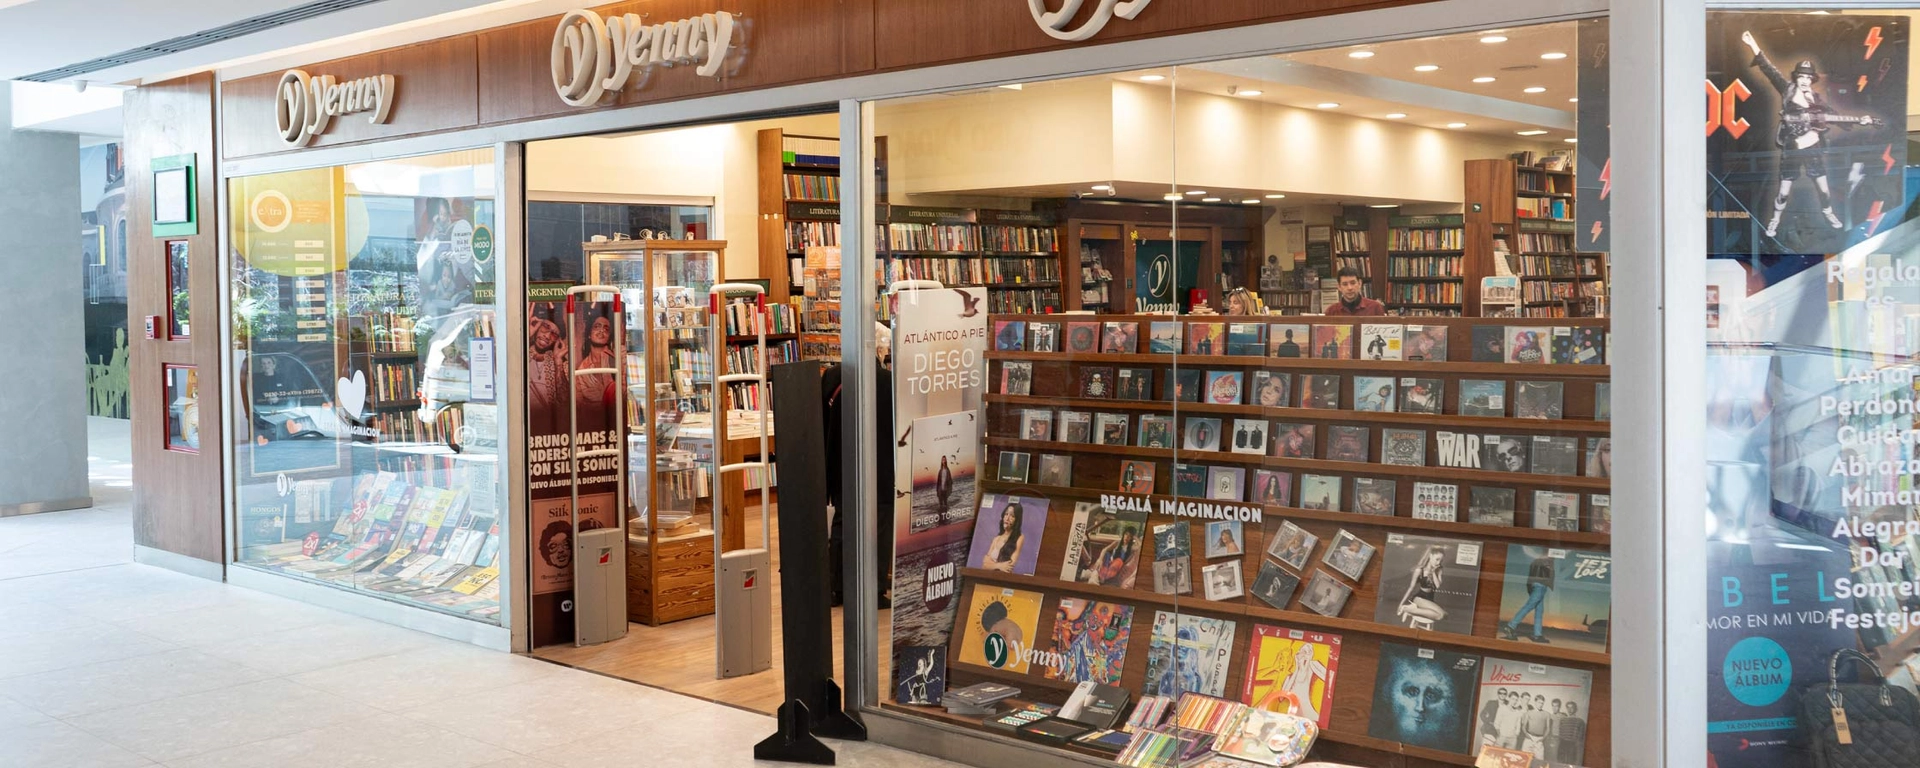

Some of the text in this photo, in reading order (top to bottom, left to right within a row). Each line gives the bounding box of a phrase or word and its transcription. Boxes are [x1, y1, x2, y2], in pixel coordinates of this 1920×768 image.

[603, 10, 735, 92] Yenny
[309, 74, 395, 136] Yenny
[475, 289, 494, 298] ITER
[528, 287, 567, 296] ARGENTIN
[904, 328, 984, 344] ATLÁNTICO A PIE
[914, 348, 975, 374] DIEGO
[907, 369, 980, 395] TORRES
[576, 431, 606, 445] MARS
[1436, 432, 1481, 469] WAR
[583, 457, 618, 472] SONIC
[531, 481, 548, 489] UEVO
[251, 506, 281, 514] HONGOS
[548, 504, 599, 518] Silk onic
[915, 507, 971, 527] DIEGO TORRES
[1100, 494, 1262, 523] REGALÁ IMAGINACION
[1832, 517, 1920, 540] Alegra
[1860, 547, 1908, 569] Dar
[927, 562, 955, 585] NUEVO
[925, 578, 954, 602] ÁLBUM
[1706, 616, 1742, 630] MOR
[1747, 614, 1768, 628] EN
[1774, 611, 1792, 625] MI
[1257, 627, 1342, 646] Vius
[1010, 640, 1067, 676] Yenny
[1731, 657, 1783, 673] NUEVO
[1490, 664, 1522, 684] Virus
[1735, 671, 1783, 688] ÁLBUM
[1737, 721, 1775, 730] DISPONIBLE
